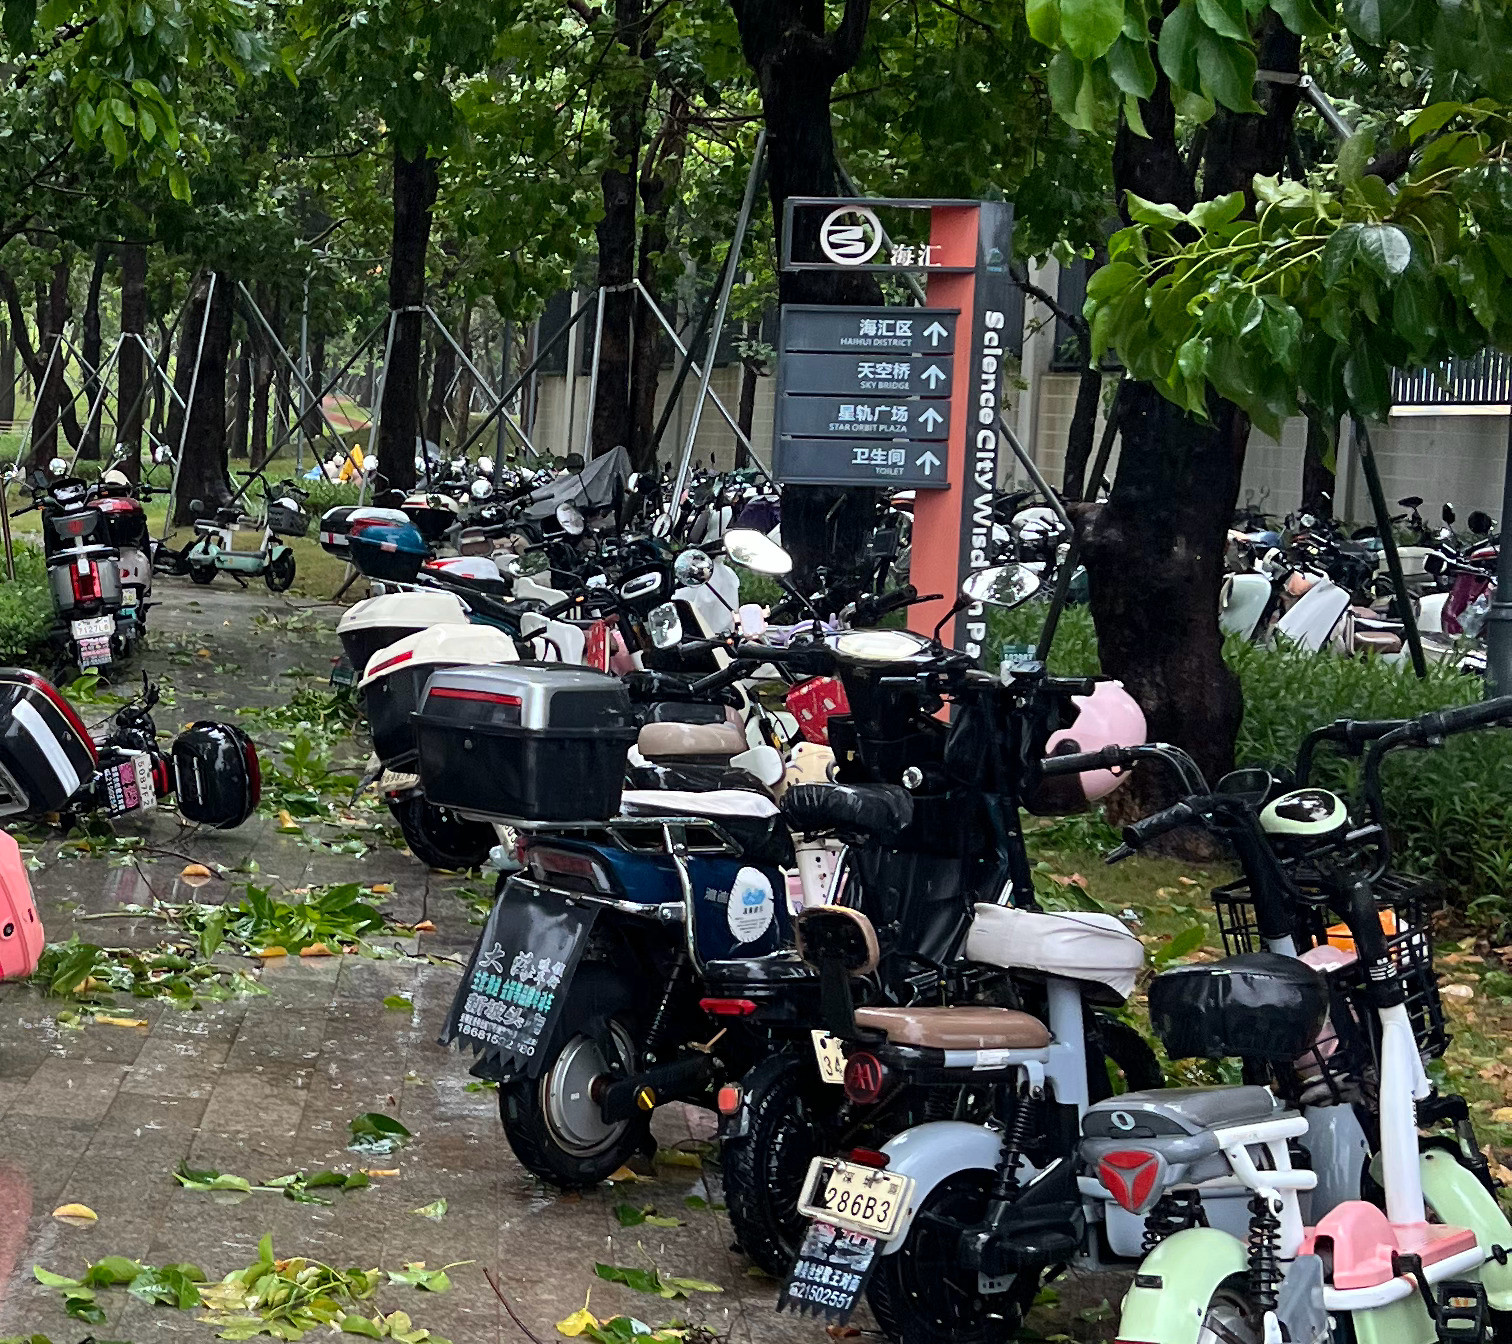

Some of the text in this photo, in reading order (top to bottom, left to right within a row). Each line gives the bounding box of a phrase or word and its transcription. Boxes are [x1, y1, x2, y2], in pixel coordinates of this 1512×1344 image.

[890, 242, 941, 266] 海汇
[859, 319, 913, 336] 海汇区
[840, 338, 913, 347] HAIHUI DISTRICT
[858, 362, 910, 379] 天空桥
[979, 311, 1005, 425] Science
[860, 381, 910, 389] SKY BRIDGE
[838, 405, 909, 422] 星轨广场
[829, 423, 907, 433] STAR ORBIT PLAZA
[851, 448, 906, 465] 卫生间
[974, 429, 996, 490] City
[876, 467, 904, 475] TOILET
[967, 493, 994, 616] Wisdm
[797, 1283, 854, 1310] 21502551
